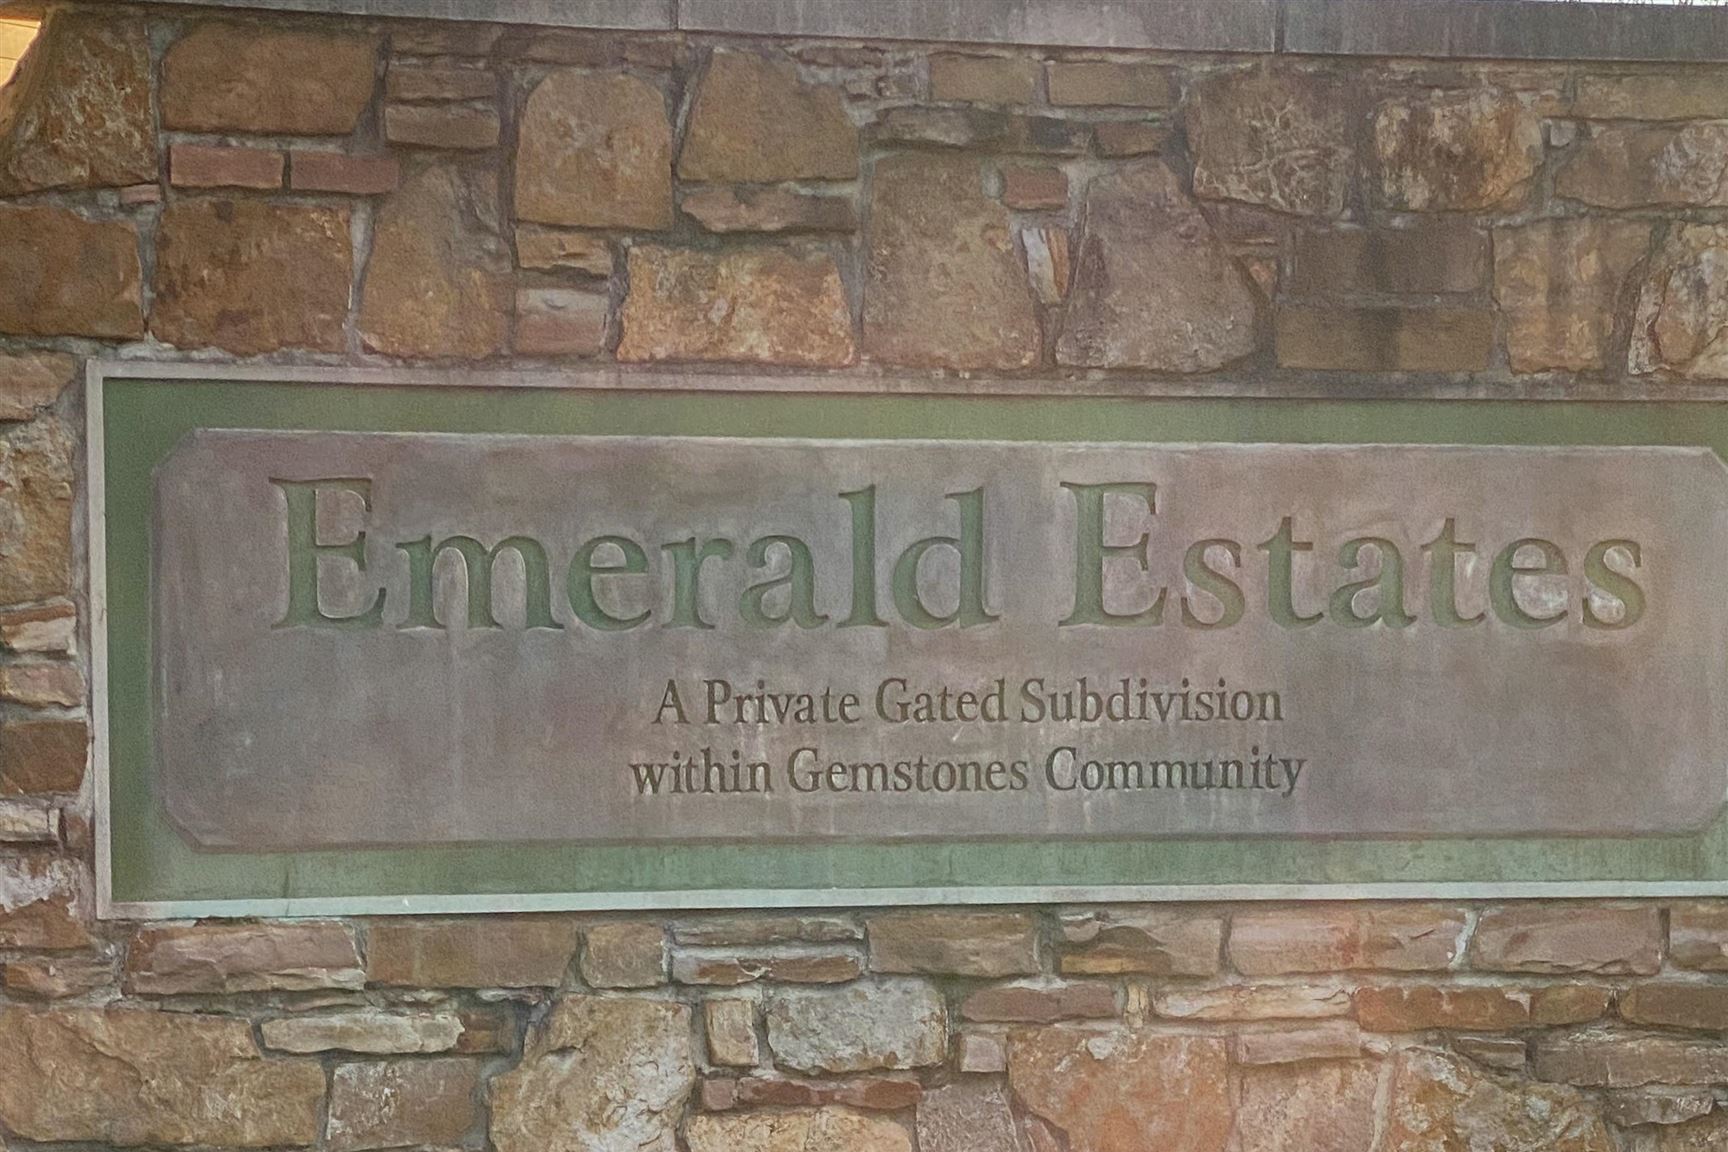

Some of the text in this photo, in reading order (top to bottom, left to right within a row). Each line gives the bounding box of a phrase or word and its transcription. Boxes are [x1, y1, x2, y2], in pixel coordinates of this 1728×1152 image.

[269, 476, 1647, 632] Emerald Estates
[652, 676, 1283, 725] A Private Gated Subdivision
[628, 745, 1308, 798] within Gemstones Community
